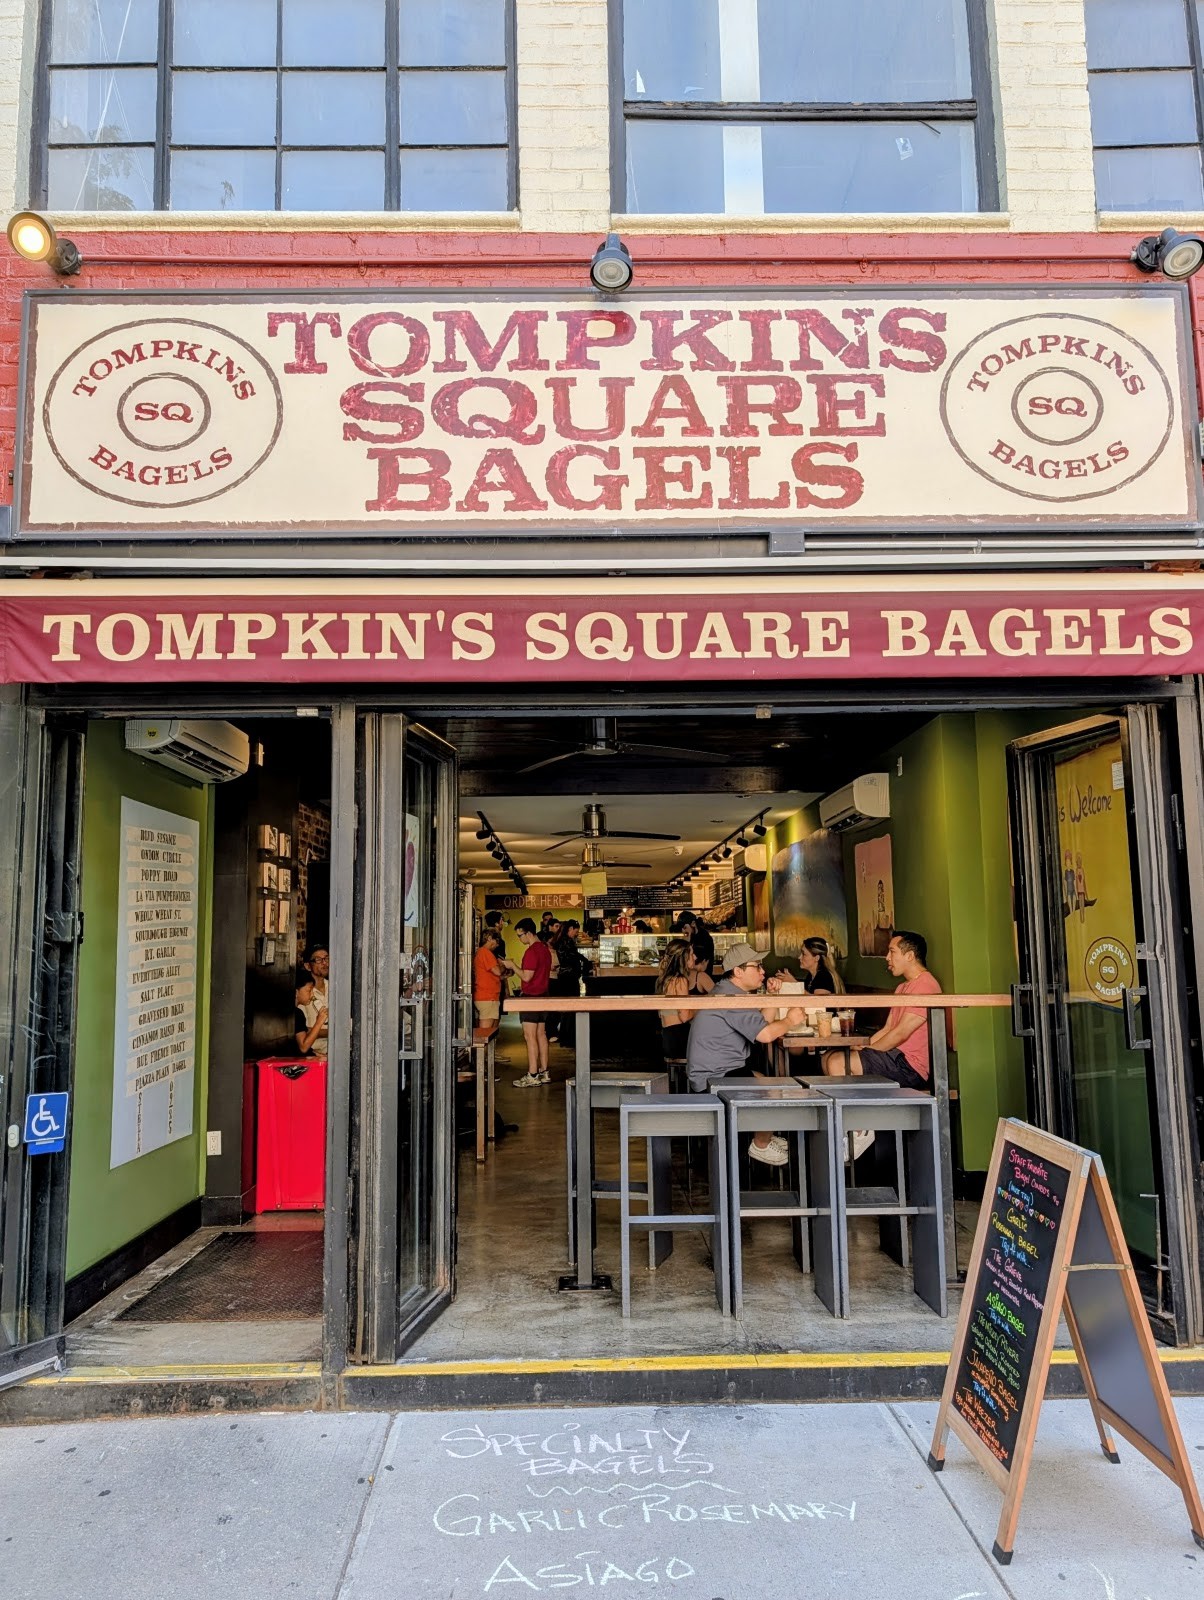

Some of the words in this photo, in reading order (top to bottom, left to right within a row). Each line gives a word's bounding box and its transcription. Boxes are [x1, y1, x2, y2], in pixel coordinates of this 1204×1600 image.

[267, 307, 947, 378] TOMPKINS
[72, 339, 256, 402] TOMPKINS
[966, 334, 1146, 396] TOMPKINS
[134, 402, 194, 423] SQ
[339, 373, 887, 445] SQUARE
[1028, 396, 1088, 418] SQ
[88, 444, 234, 486] BAGELS
[988, 438, 1130, 481] BAGELS
[365, 441, 864, 512] BAGELS
[42, 611, 496, 663] TOMPKIN'S
[526, 610, 851, 661] SQUARE
[881, 607, 1194, 659] BAGELS
[1069, 784, 1112, 822] Welcome
[141, 849, 159, 861] ONION
[162, 851, 181, 863] CIRCLE
[141, 869, 161, 882] POPPY
[163, 870, 178, 882] ROAD
[503, 895, 538, 908] ORDER
[540, 894, 566, 907] HERE
[155, 909, 172, 920] WHEAT
[156, 946, 176, 959] GARLIC
[1089, 944, 1128, 966] TOMPKINS
[165, 965, 180, 978] ALLEY
[1102, 966, 1115, 974] SQ
[140, 989, 155, 1003] SALT
[157, 985, 174, 999] PLACE
[138, 1006, 168, 1026] GRAVESEND
[132, 1029, 159, 1050] CINNAMON
[136, 1053, 148, 1070] RUE
[170, 1040, 186, 1055] TOAST
[135, 1073, 155, 1092] PIAZZA
[1009, 1149, 1027, 1168] STAFF
[1018, 1235, 1039, 1259] BAGEL
[1007, 1310, 1027, 1337] BAGEL
[440, 1422, 690, 1459] SPECIALTY
[515, 1452, 714, 1476] BAGELS
[433, 1494, 628, 1537] GARLIC
[629, 1494, 856, 1524] ROSEMARY
[483, 1551, 695, 1592] ASIAGO
